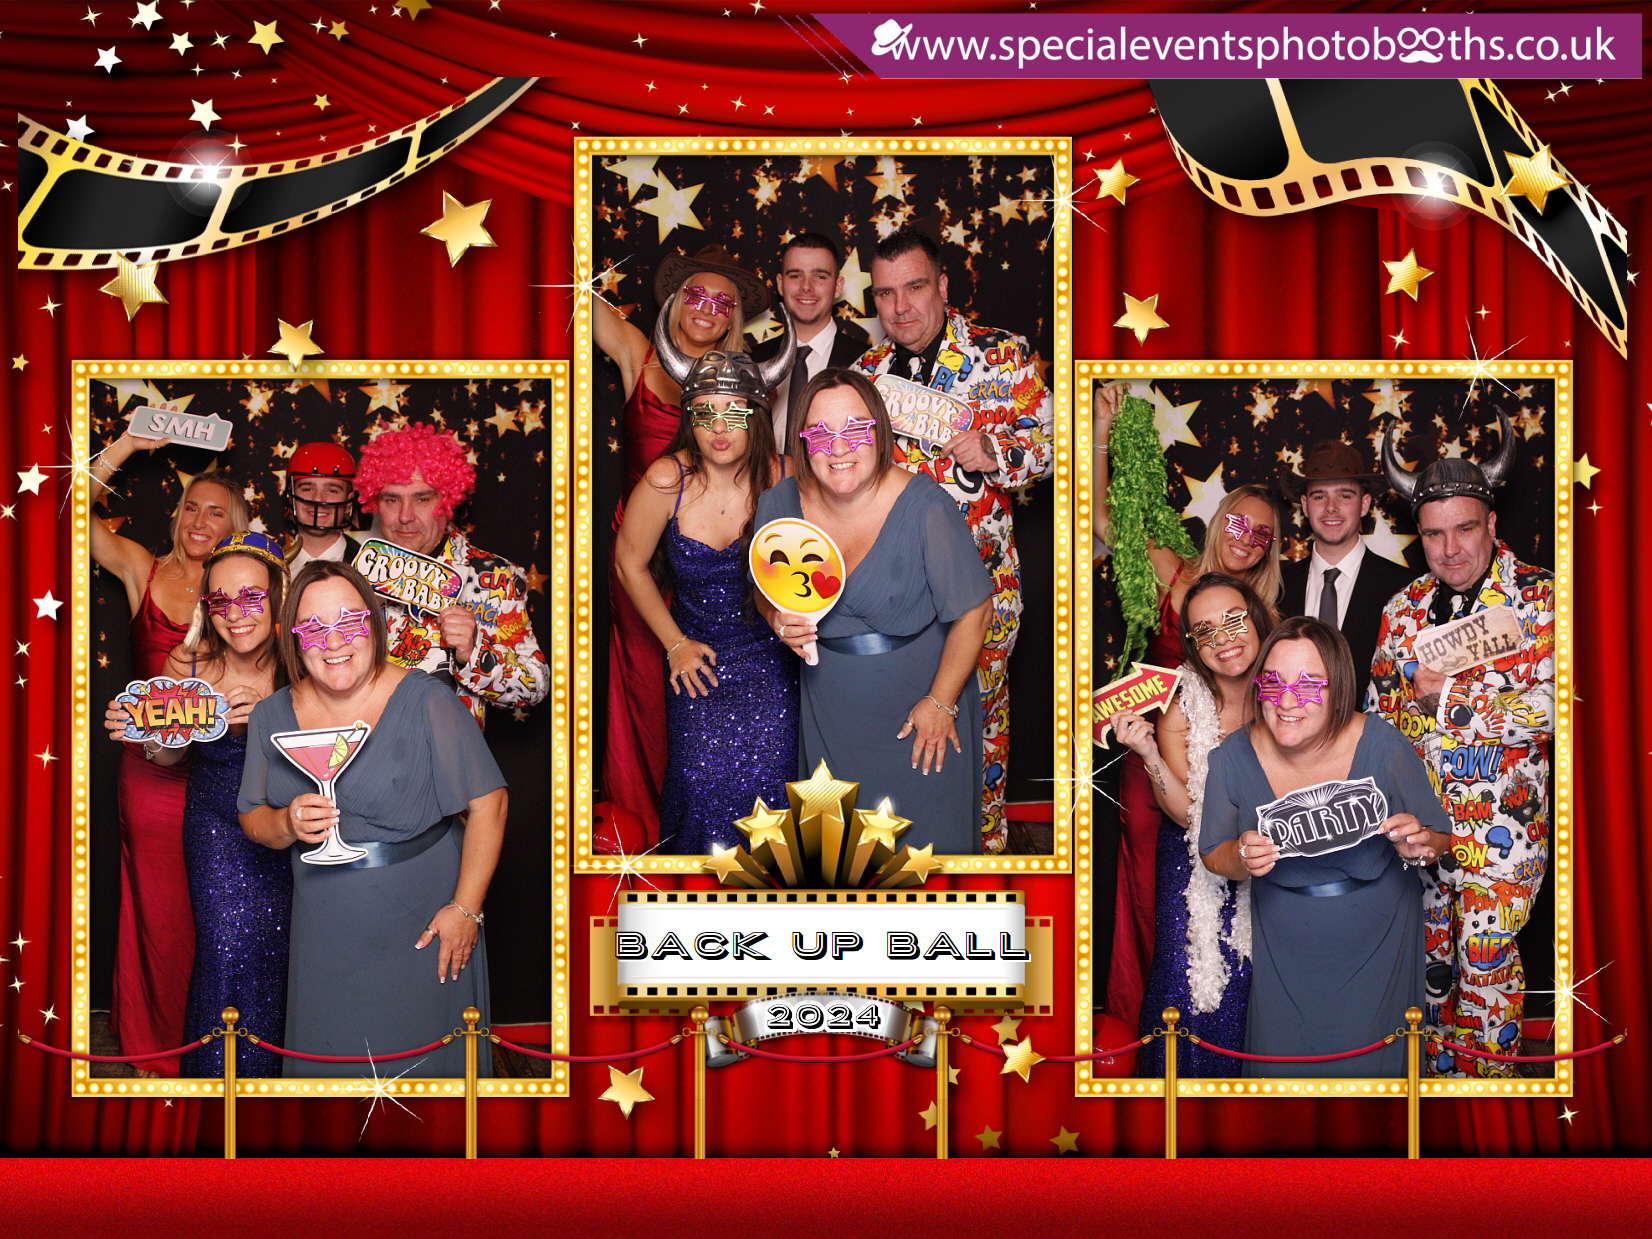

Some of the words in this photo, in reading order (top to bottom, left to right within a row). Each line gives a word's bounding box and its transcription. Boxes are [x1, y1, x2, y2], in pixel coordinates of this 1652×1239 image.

[148, 413, 217, 441] SMH
[911, 413, 959, 443] BAB
[356, 548, 450, 591] GROOVY
[1418, 614, 1489, 664] HOWDY
[1466, 633, 1517, 662] Y'ALL
[121, 697, 217, 731] YEAH!
[1092, 674, 1169, 725] AWESOME
[1440, 744, 1503, 783] POW!
[1265, 792, 1382, 850] PARTY
[1453, 800, 1493, 821] BAM
[1461, 887, 1500, 913] POW
